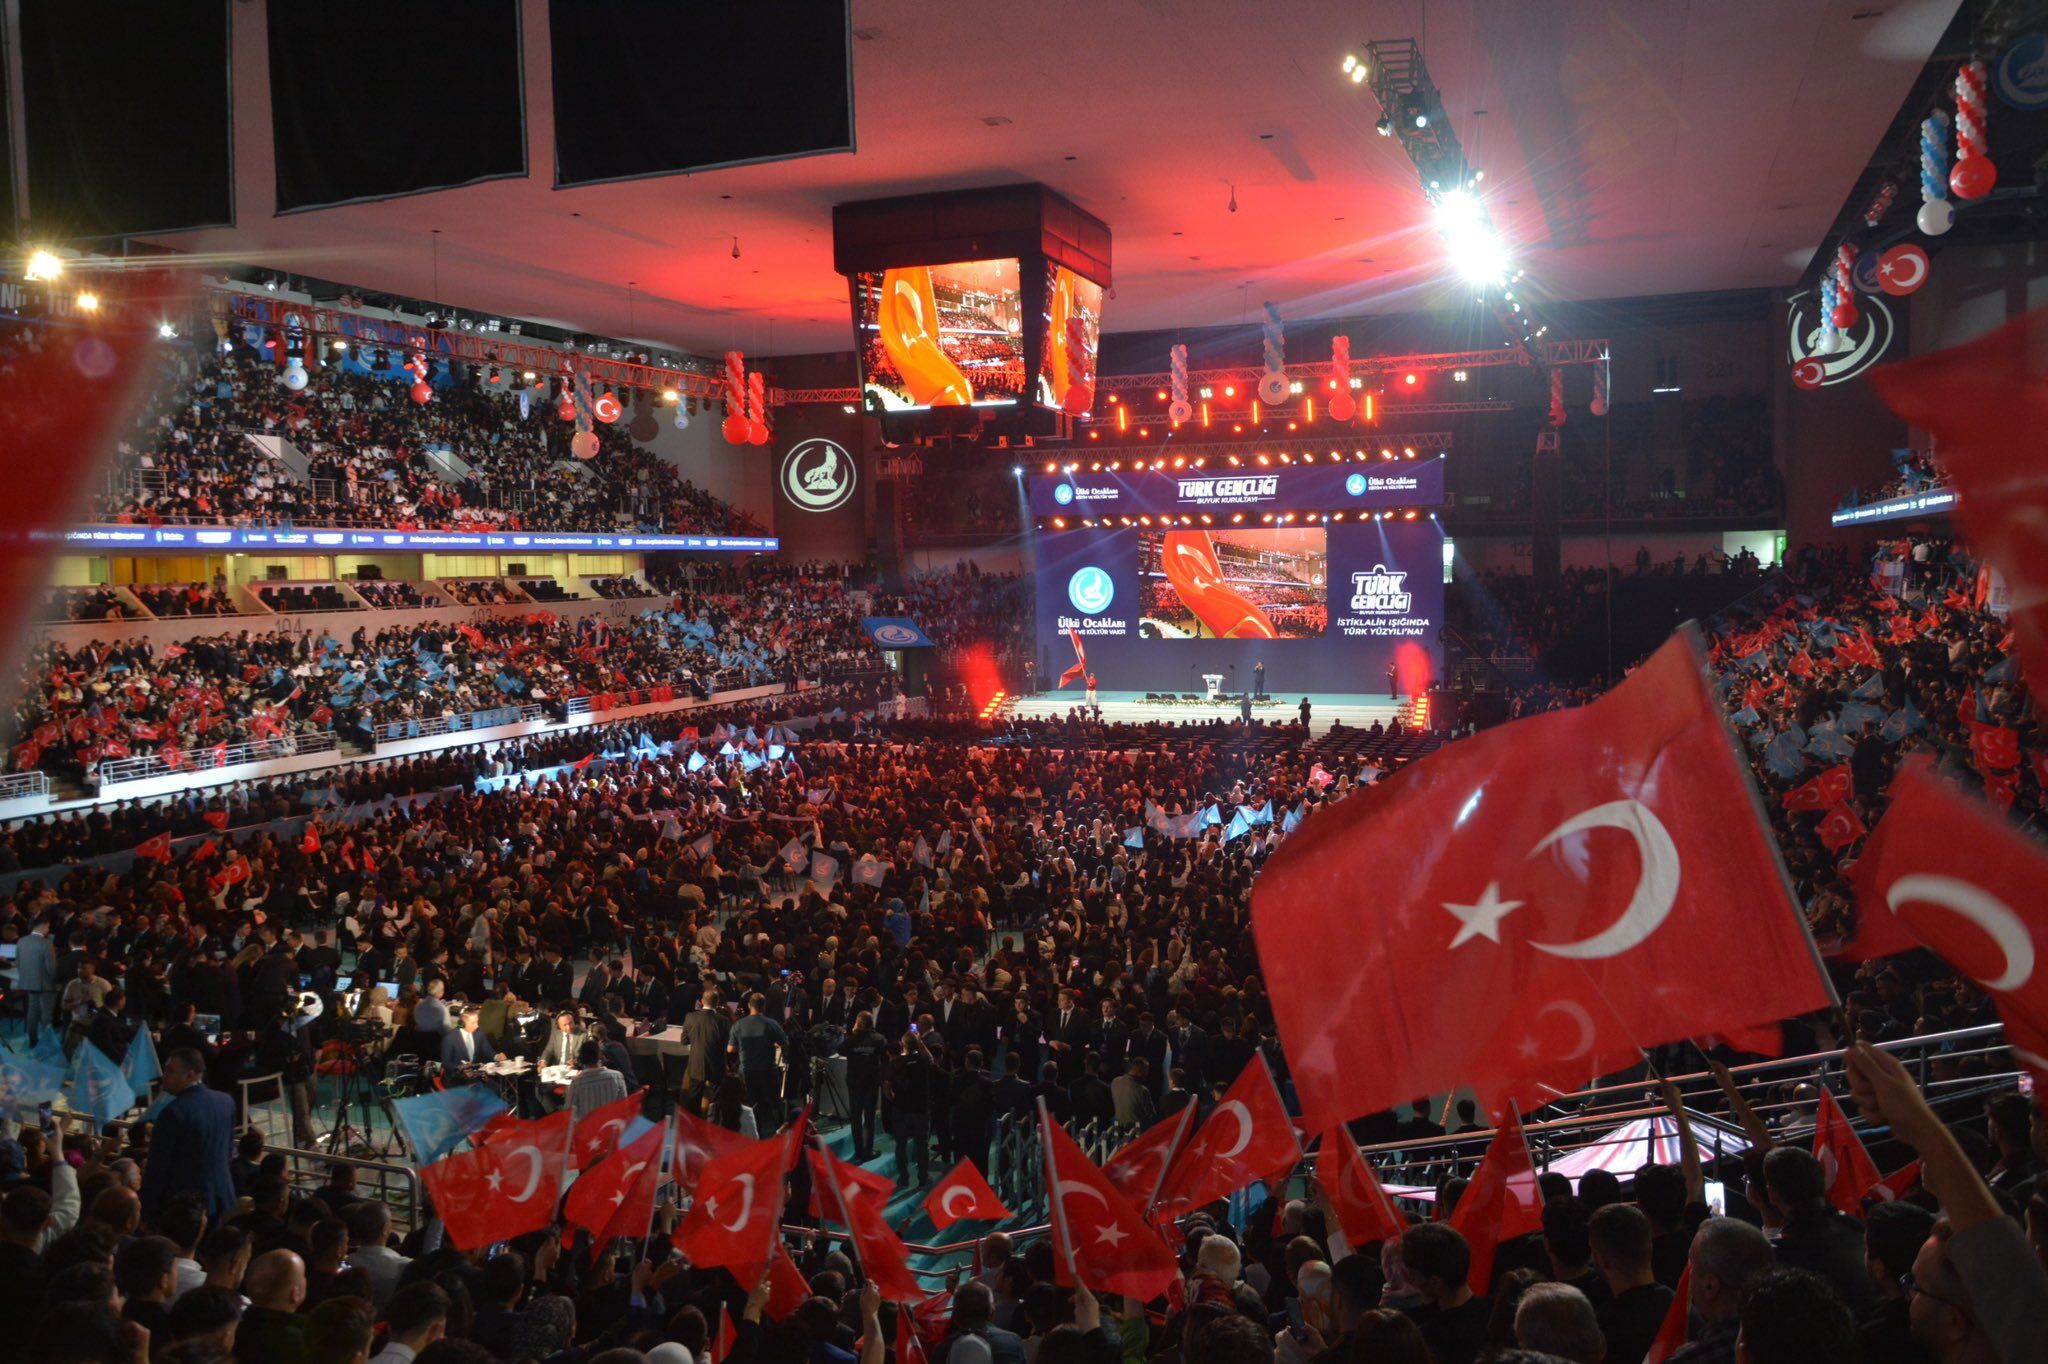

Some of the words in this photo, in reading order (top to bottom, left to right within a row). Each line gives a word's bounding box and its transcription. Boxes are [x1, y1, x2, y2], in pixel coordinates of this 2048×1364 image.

[610, 601, 627, 617] 102
[275, 616, 302, 638] 104
[1057, 616, 1080, 628] Ülkü
[1388, 617, 1430, 628] IŞIĞINDA
[1343, 627, 1368, 635] TÜRK
